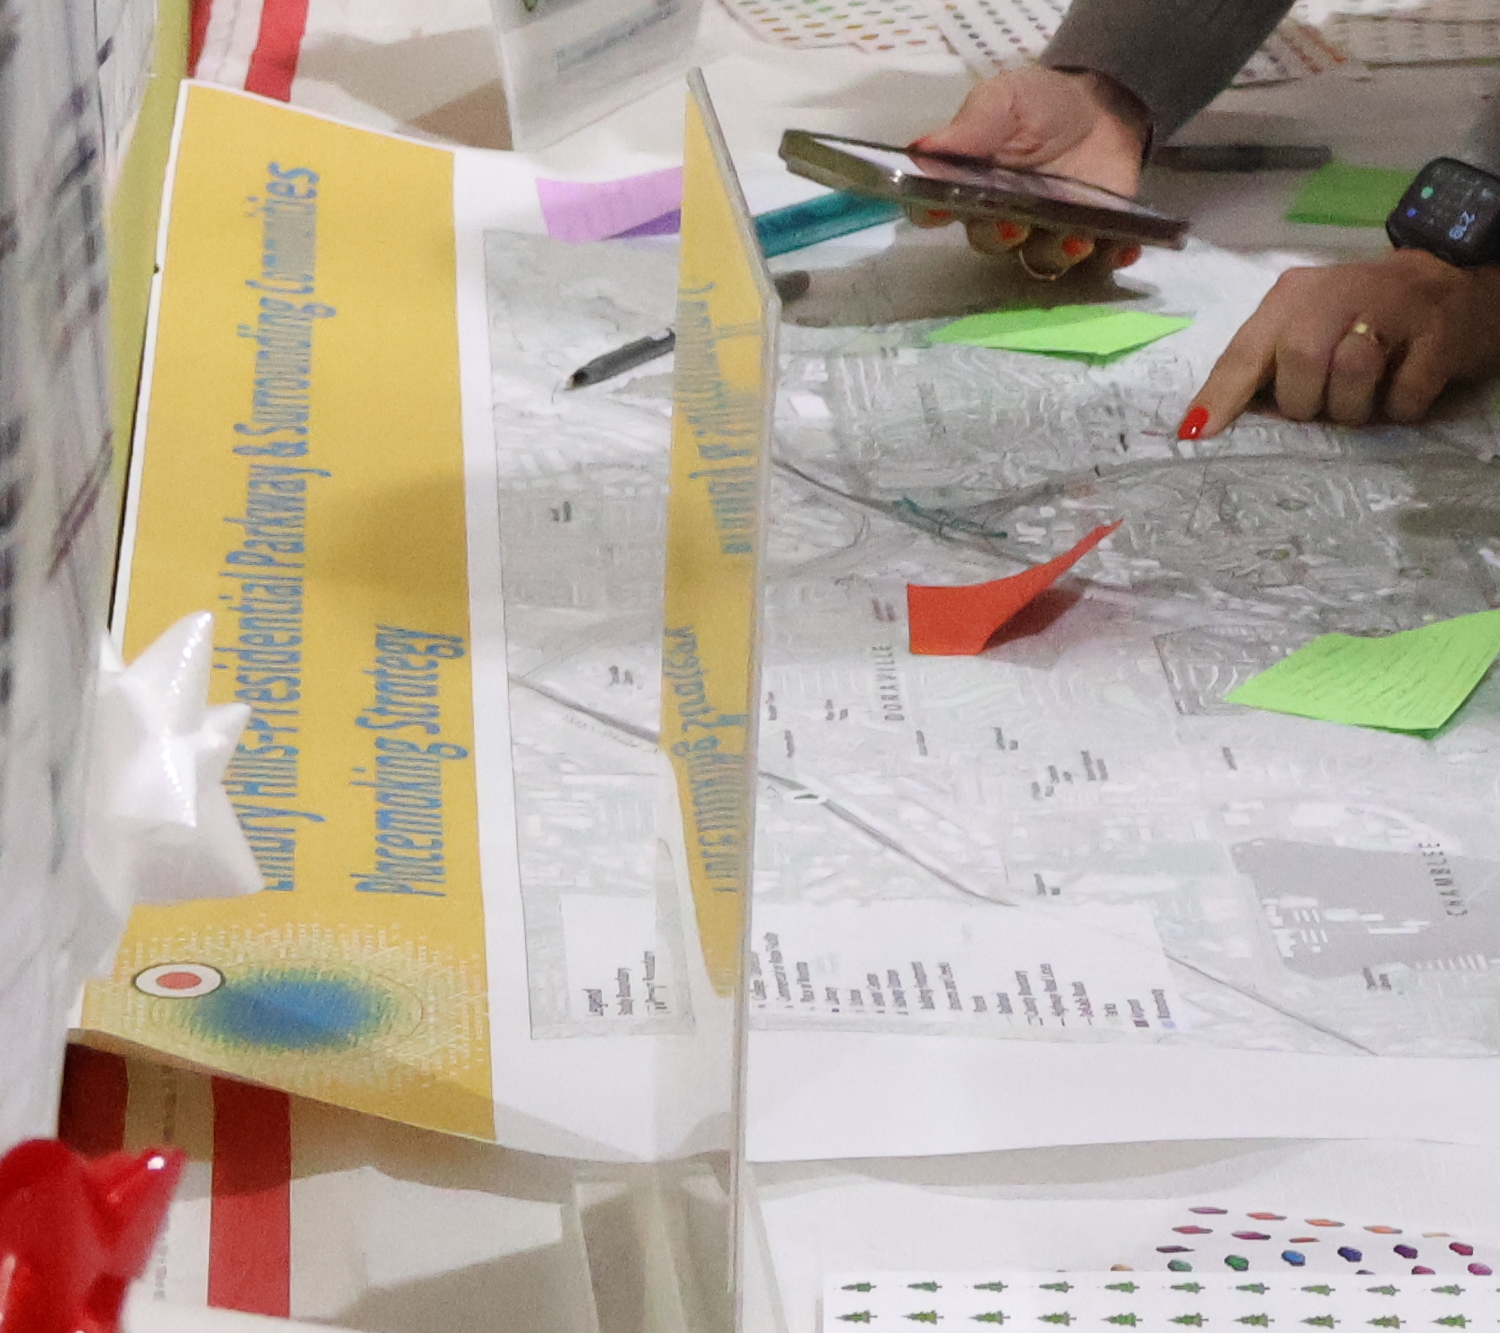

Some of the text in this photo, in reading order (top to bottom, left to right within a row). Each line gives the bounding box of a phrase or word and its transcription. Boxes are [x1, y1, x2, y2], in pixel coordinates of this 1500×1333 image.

[233, 296, 337, 434] Surrounding
[232, 440, 308, 458] &
[222, 464, 332, 568] Parkway
[871, 644, 905, 721] DORAVILLE
[349, 623, 470, 897] Placemaking Strategy
